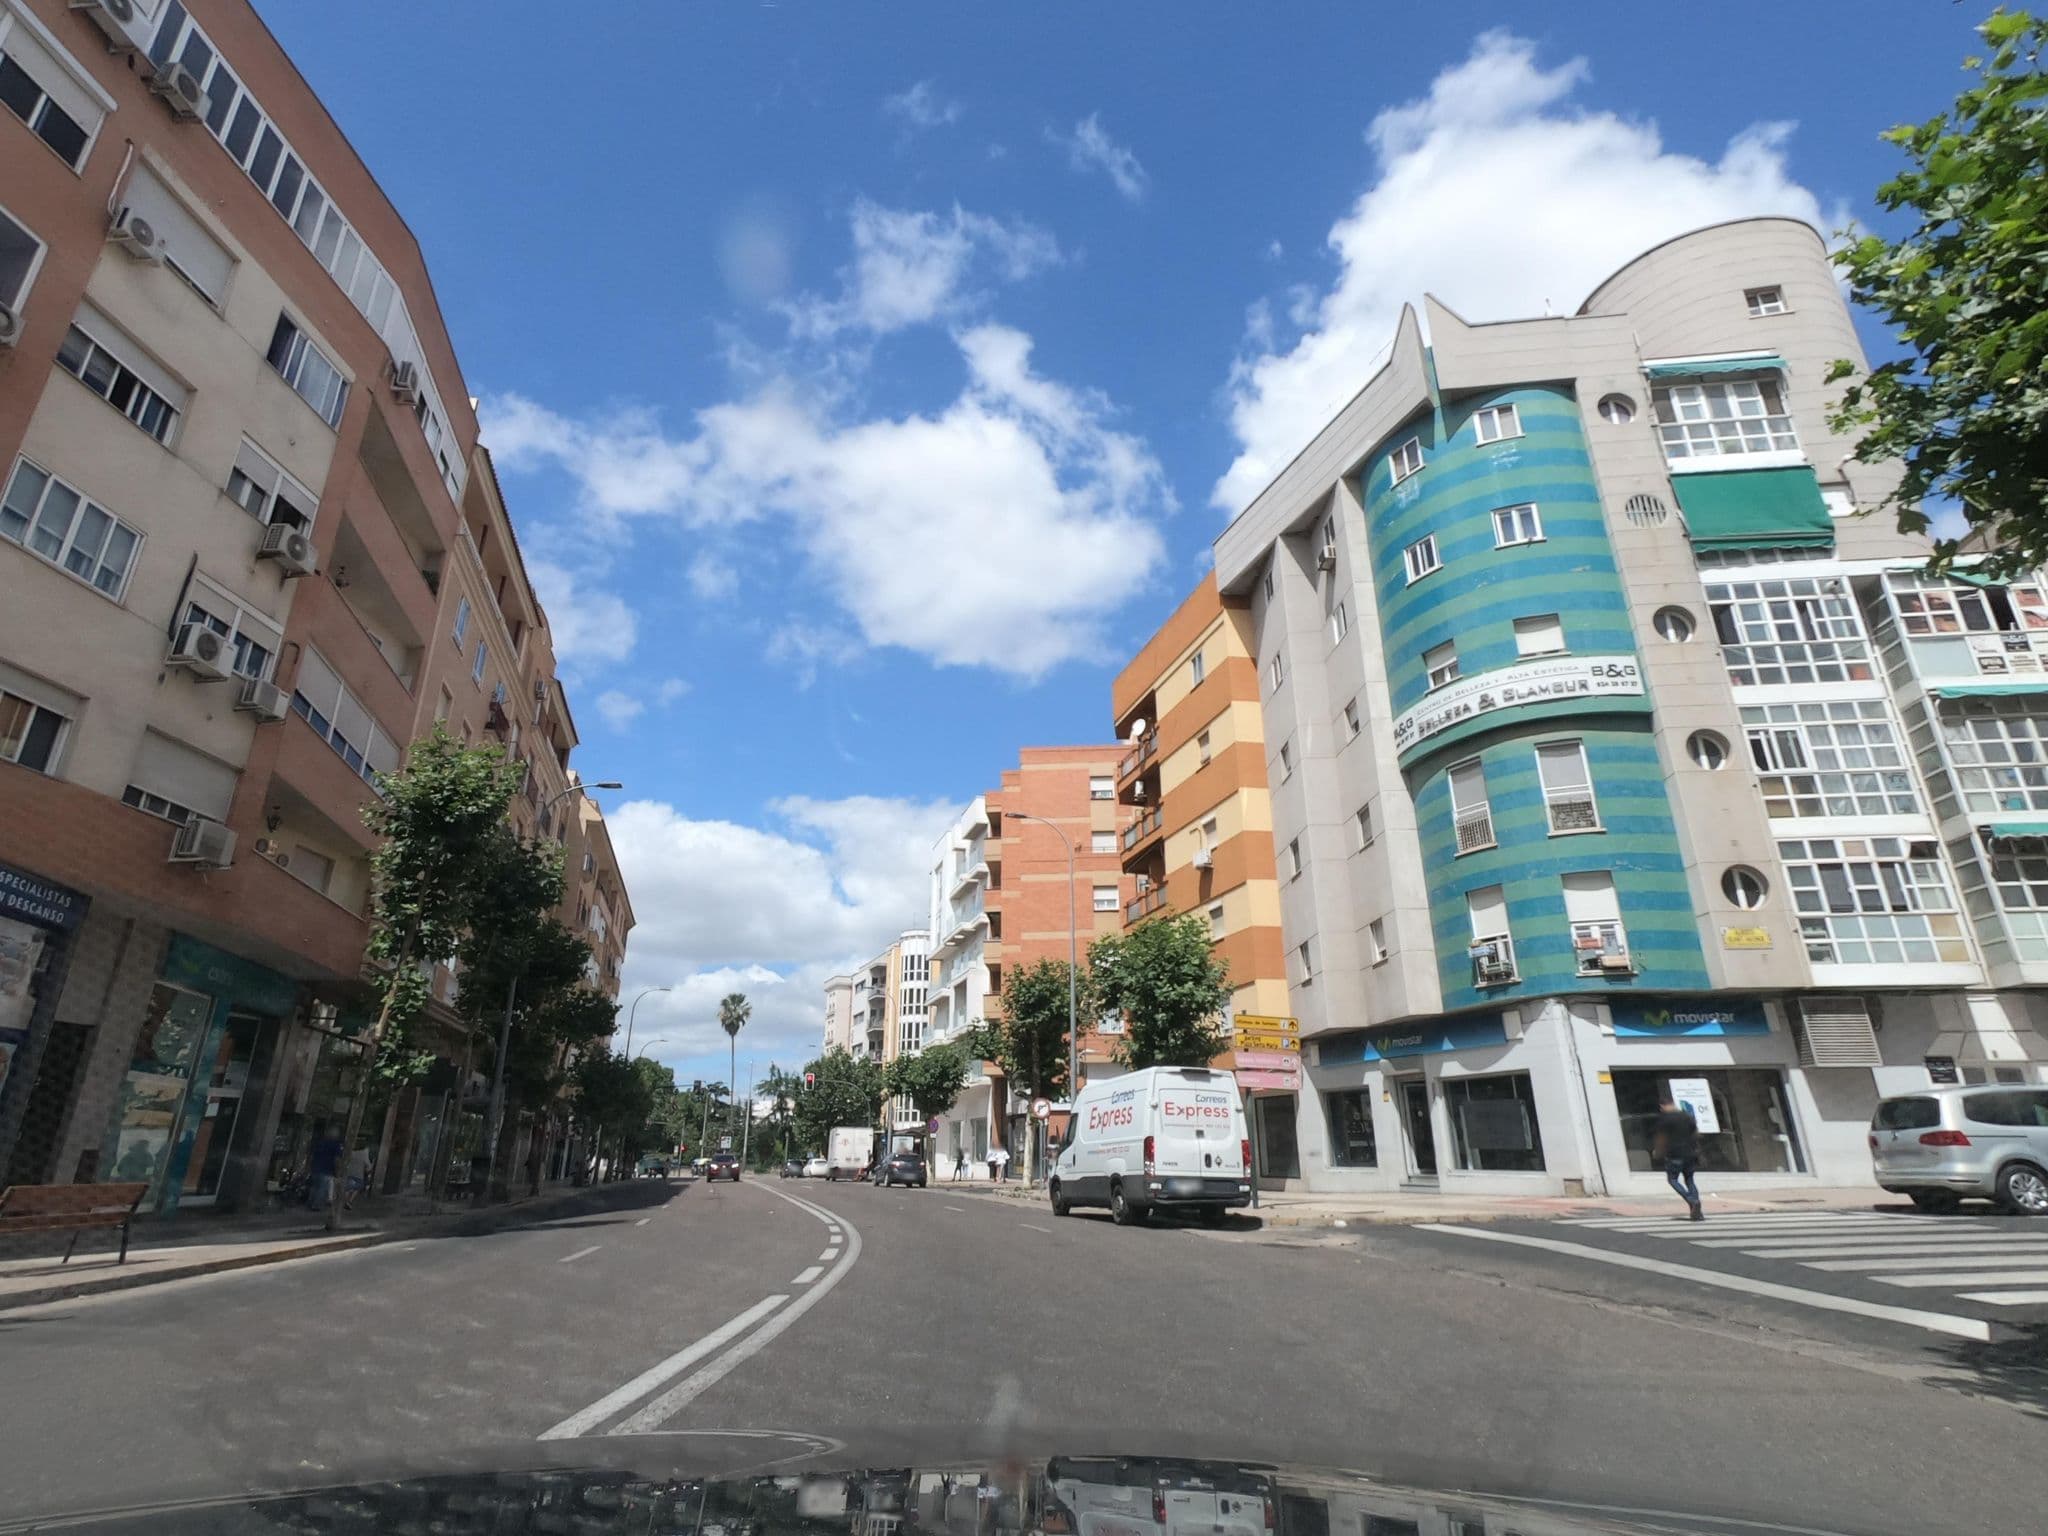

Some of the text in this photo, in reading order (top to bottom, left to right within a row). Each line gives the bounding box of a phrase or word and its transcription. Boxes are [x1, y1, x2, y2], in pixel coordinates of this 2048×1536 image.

[1591, 664, 1636, 678] B&G
[1478, 693, 1497, 712] &
[1502, 679, 1590, 703] GLAMOUR
[7, 894, 64, 923] DESCANSO
[1673, 1011, 1735, 1024] movistar
[1392, 1035, 1423, 1048] movistar
[1111, 1089, 1135, 1104] Correos
[1195, 1094, 1227, 1104] Correos
[1165, 1102, 1229, 1120] Express
[1089, 1105, 1133, 1134] Express
